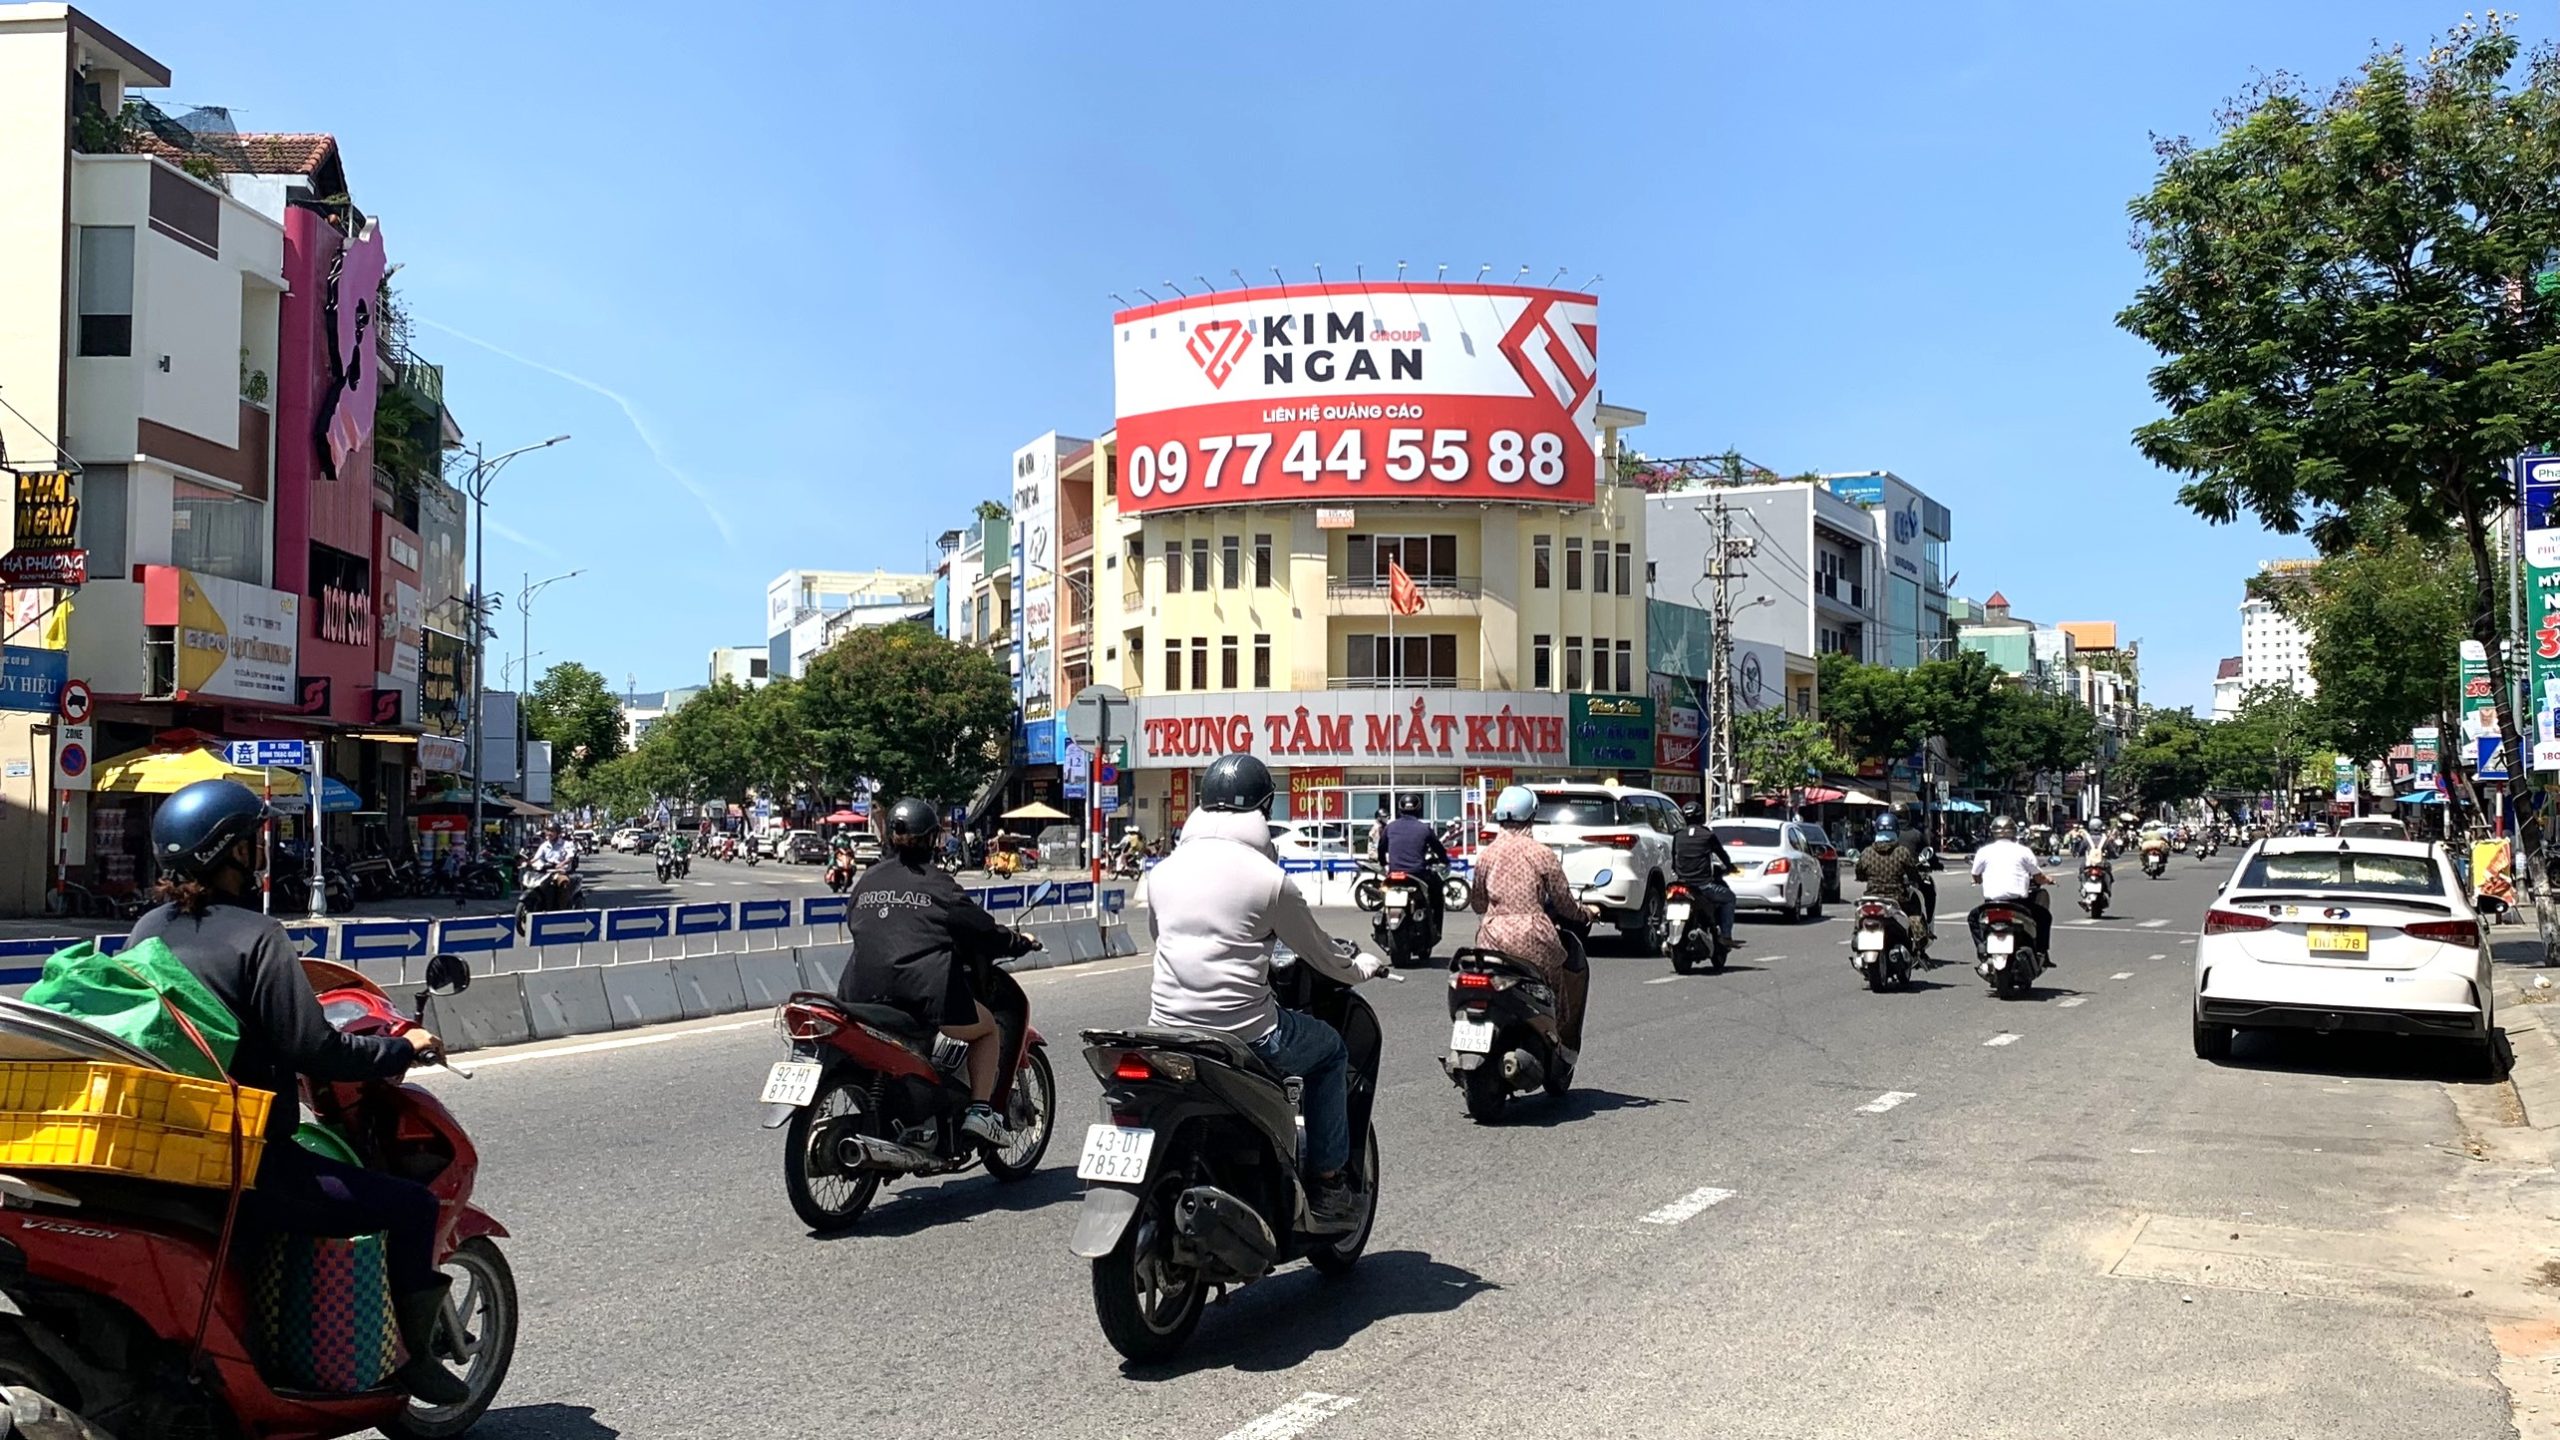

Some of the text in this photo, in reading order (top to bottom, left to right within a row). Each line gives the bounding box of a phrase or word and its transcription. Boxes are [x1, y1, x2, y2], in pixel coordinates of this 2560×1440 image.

[1264, 311, 1421, 347] KIM GROUP
[1264, 348, 1423, 385] NGAN
[1263, 402, 1423, 423] LIÊN HỆ QUẢNG CÁO
[1129, 429, 1565, 498] 09 77 44 55 88
[19, 470, 70, 503] NHÀ
[65, 728, 83, 739] ZONE
[1144, 696, 1565, 756] TRUNG TÂM MẮT KÍNH
[768, 1084, 806, 1101] 8712
